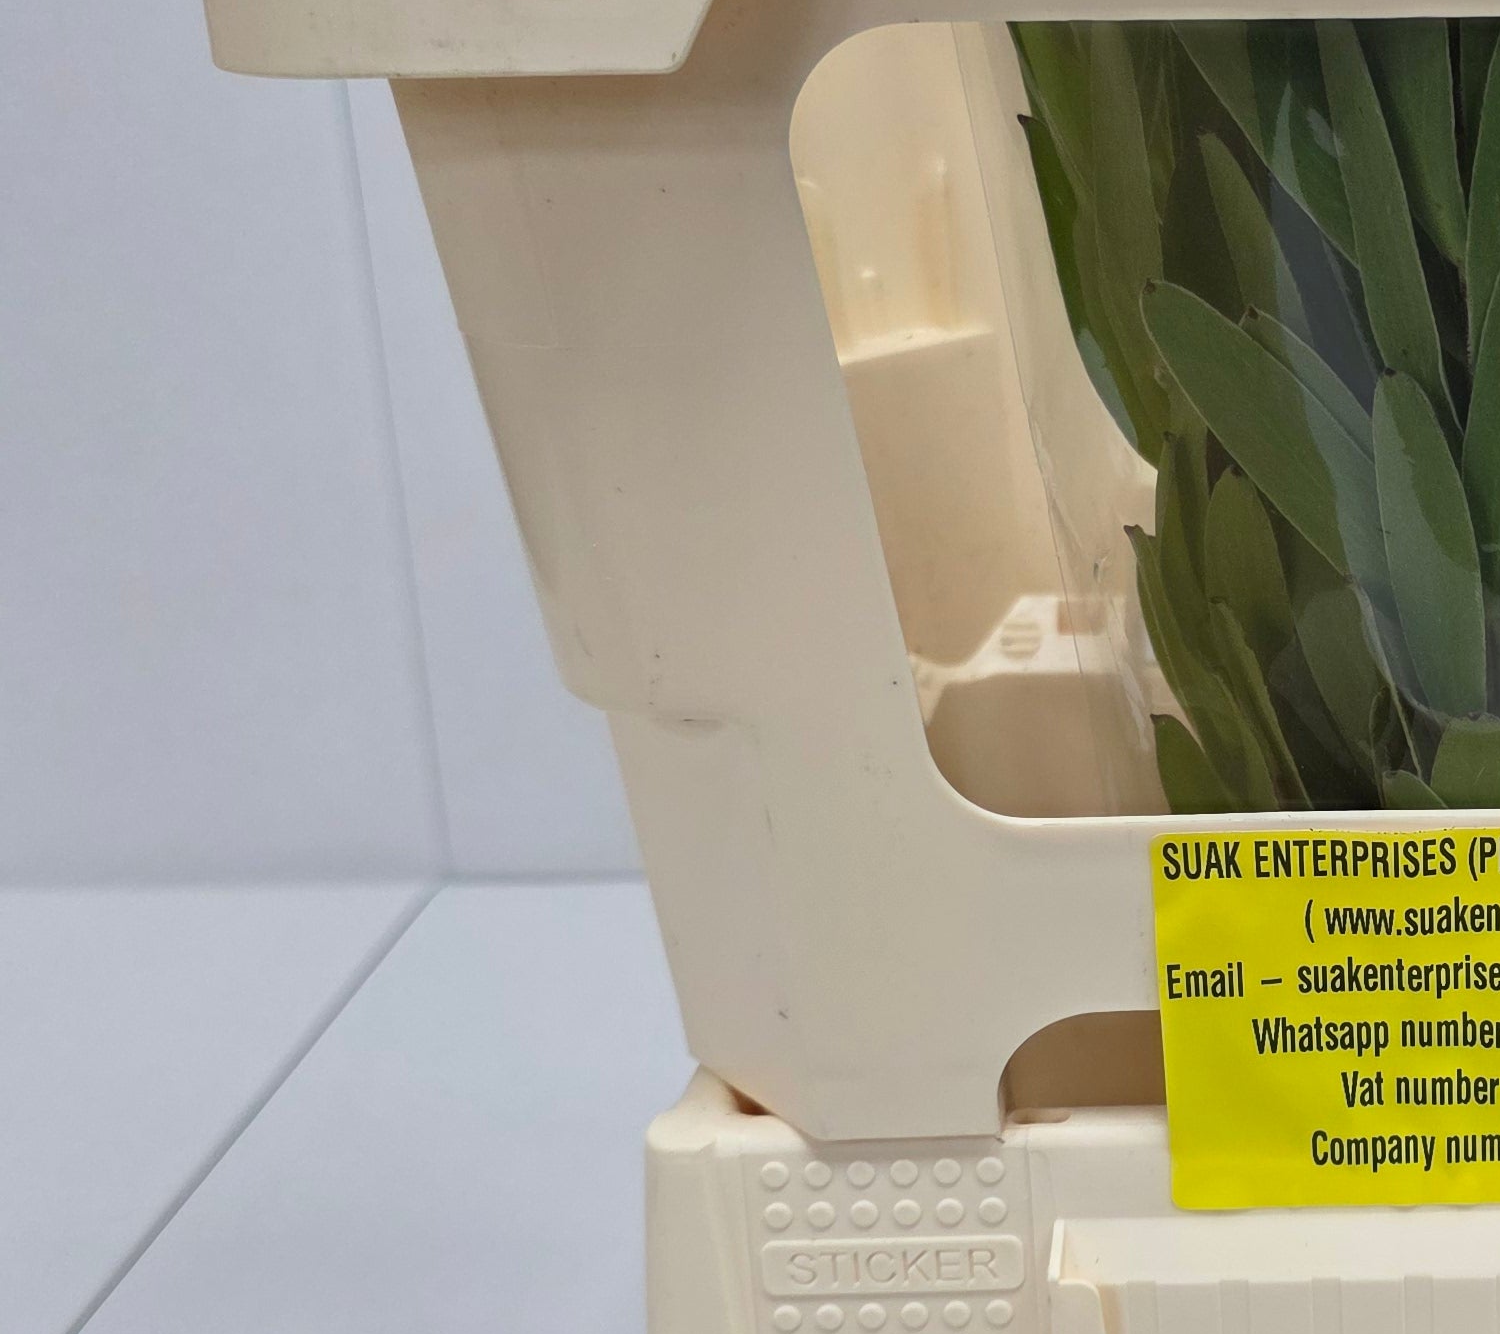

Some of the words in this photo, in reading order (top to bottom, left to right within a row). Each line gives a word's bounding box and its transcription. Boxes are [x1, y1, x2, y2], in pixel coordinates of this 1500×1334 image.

[1162, 841, 1243, 881] SUAK
[1253, 836, 1457, 879] ENTERPRISES
[1166, 961, 1244, 1000] Email
[1251, 1016, 1390, 1058] Whatsapp
[1340, 1070, 1385, 1108] Vat
[1396, 1068, 1500, 1106] number
[1311, 1129, 1436, 1174] Company
[788, 1247, 1000, 1285] STICKER
